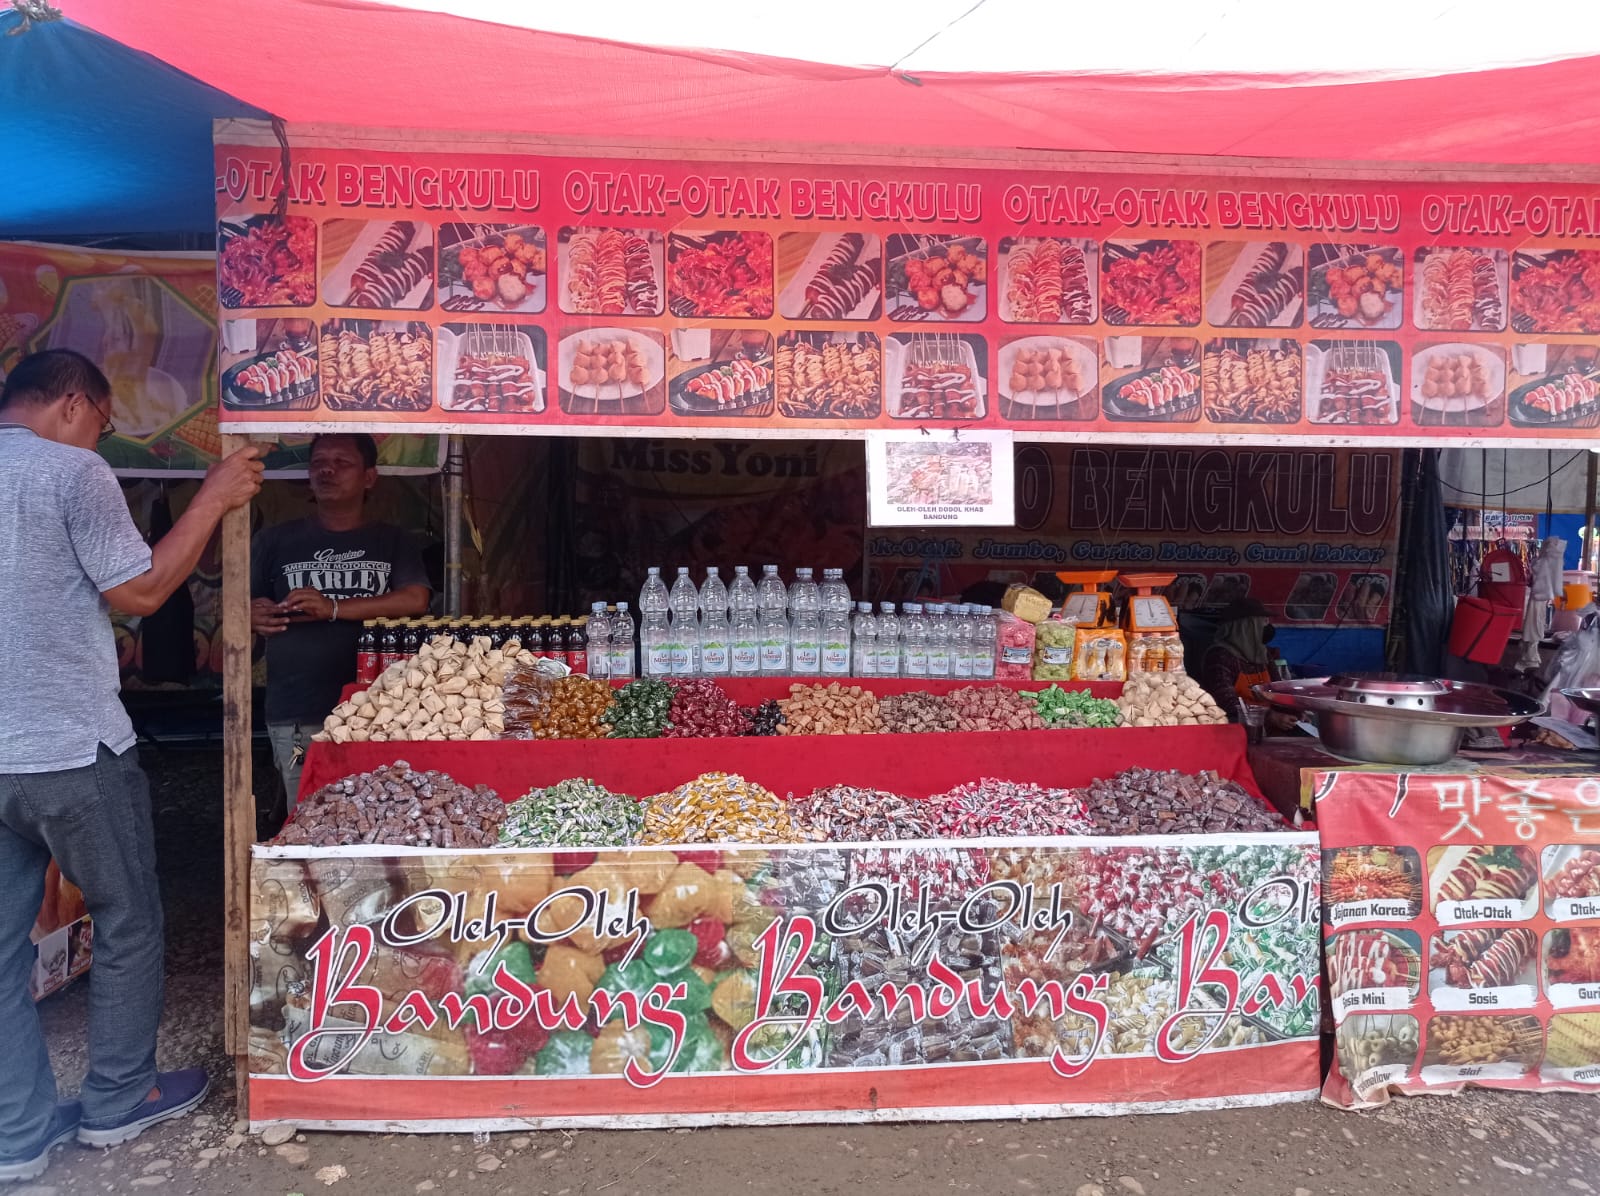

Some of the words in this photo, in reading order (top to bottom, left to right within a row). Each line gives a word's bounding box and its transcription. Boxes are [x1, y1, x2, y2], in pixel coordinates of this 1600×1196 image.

[336, 163, 541, 212] BENGKULU
[562, 169, 781, 219] OTAK-OTAK
[788, 179, 983, 223] BENGKULU
[1002, 183, 1208, 228] OTAK-OTAK
[1216, 190, 1400, 233] BENGKULU
[1421, 194, 1600, 238] OTAK-OTA
[1069, 448, 1393, 535] BENGKULU
[284, 562, 331, 573] AMERICAN
[313, 548, 366, 561] Genuine
[973, 539, 1067, 563] Jumbo,
[1158, 542, 1240, 566] Bakar,
[1246, 542, 1309, 564] Cumi
[1312, 543, 1386, 564] Bakar
[286, 570, 391, 595] HARLEY
[380, 885, 650, 975] Oleh-Oleh
[822, 880, 1074, 965] Oleh-Oleh
[1370, 903, 1406, 916] Korea
[1453, 905, 1513, 920] Otak-Otak
[287, 923, 689, 1089] Bandung
[730, 913, 1111, 1078] Bandung
[1362, 992, 1385, 1005] Mini
[1468, 992, 1498, 1005] Sosis
